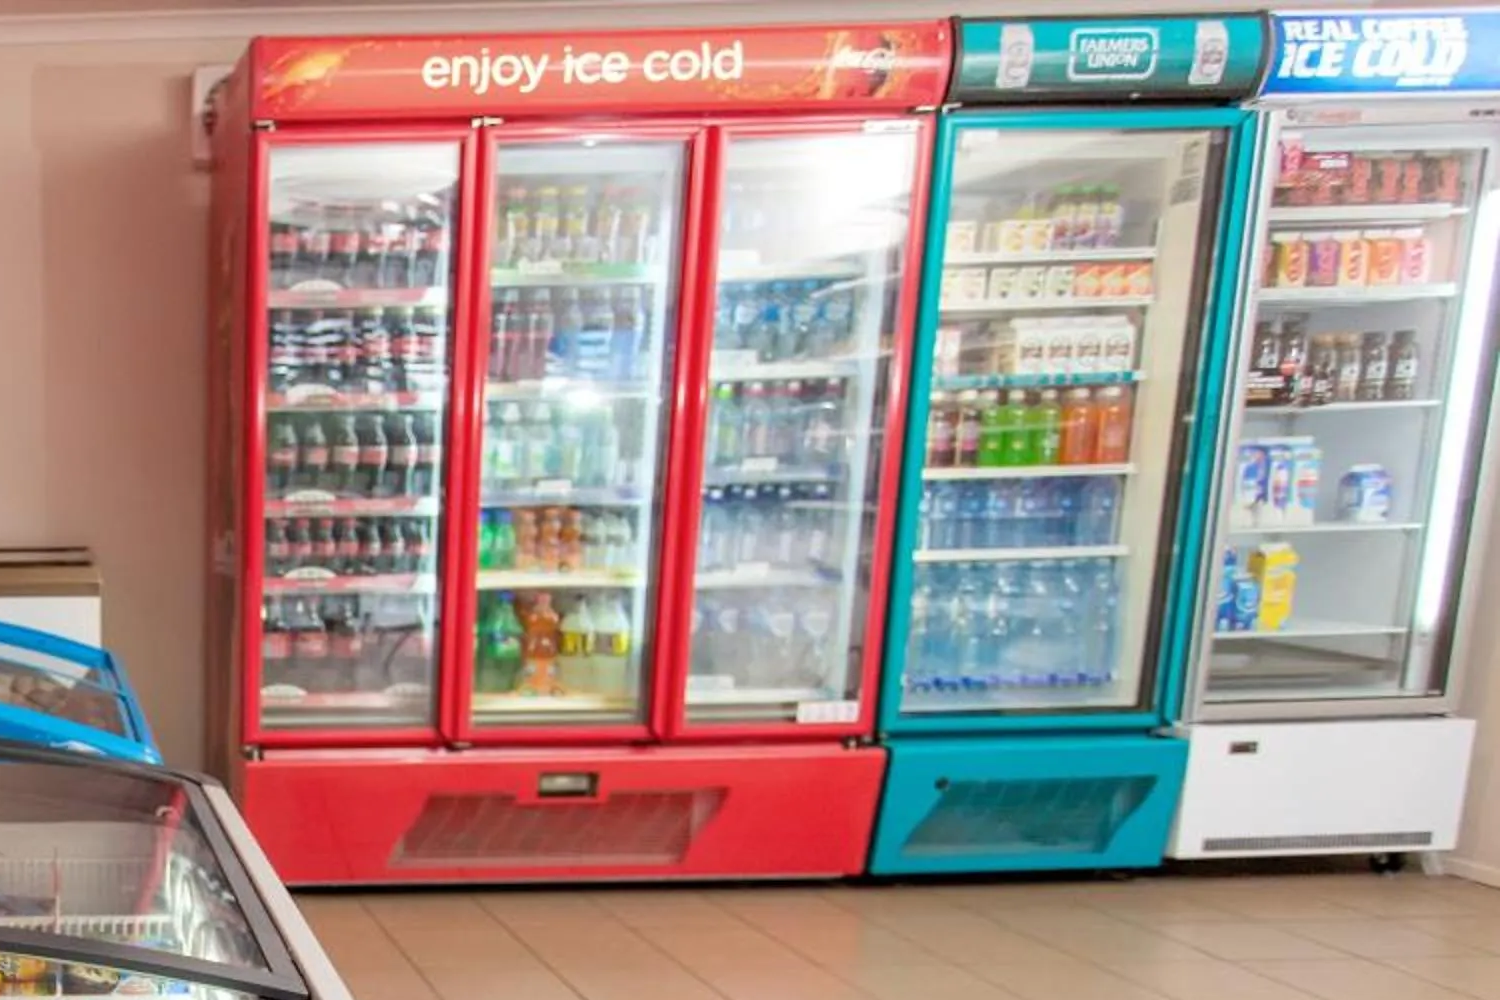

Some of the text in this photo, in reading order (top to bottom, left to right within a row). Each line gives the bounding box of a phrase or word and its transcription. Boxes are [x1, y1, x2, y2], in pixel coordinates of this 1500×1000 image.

[1281, 19, 1359, 41] REAL
[1078, 35, 1149, 54] FARMERS
[422, 41, 743, 95] enjoy ice cold
[1086, 51, 1139, 69] UNION
[1277, 39, 1469, 79] ICE COLD
